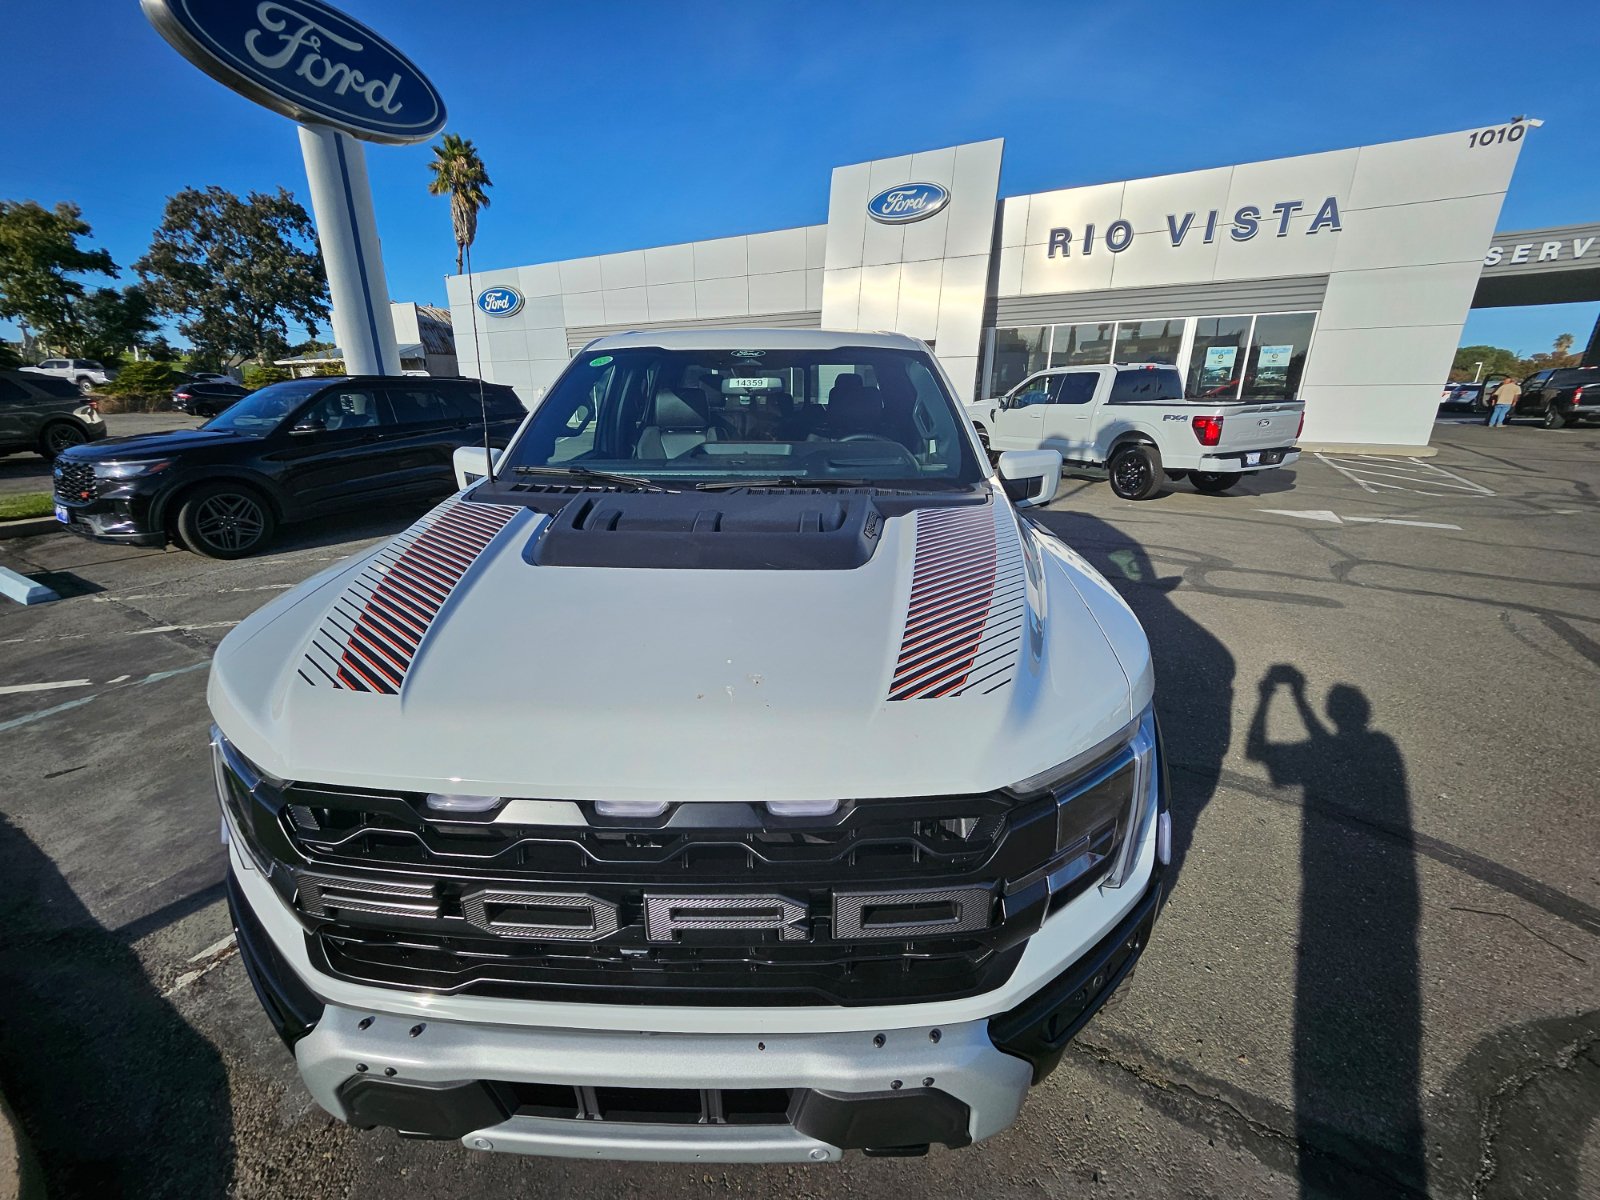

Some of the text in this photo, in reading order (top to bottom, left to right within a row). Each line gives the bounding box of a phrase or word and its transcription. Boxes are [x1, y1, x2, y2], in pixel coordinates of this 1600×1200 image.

[245, 1, 403, 115] Ford
[1469, 124, 1525, 149] 1010
[881, 188, 929, 214] Ford
[1047, 196, 1343, 260] RIO VISTA
[484, 292, 510, 311] Ford
[736, 379, 763, 387] 14359
[1162, 414, 1189, 422] FX4
[296, 868, 992, 942] FORD
